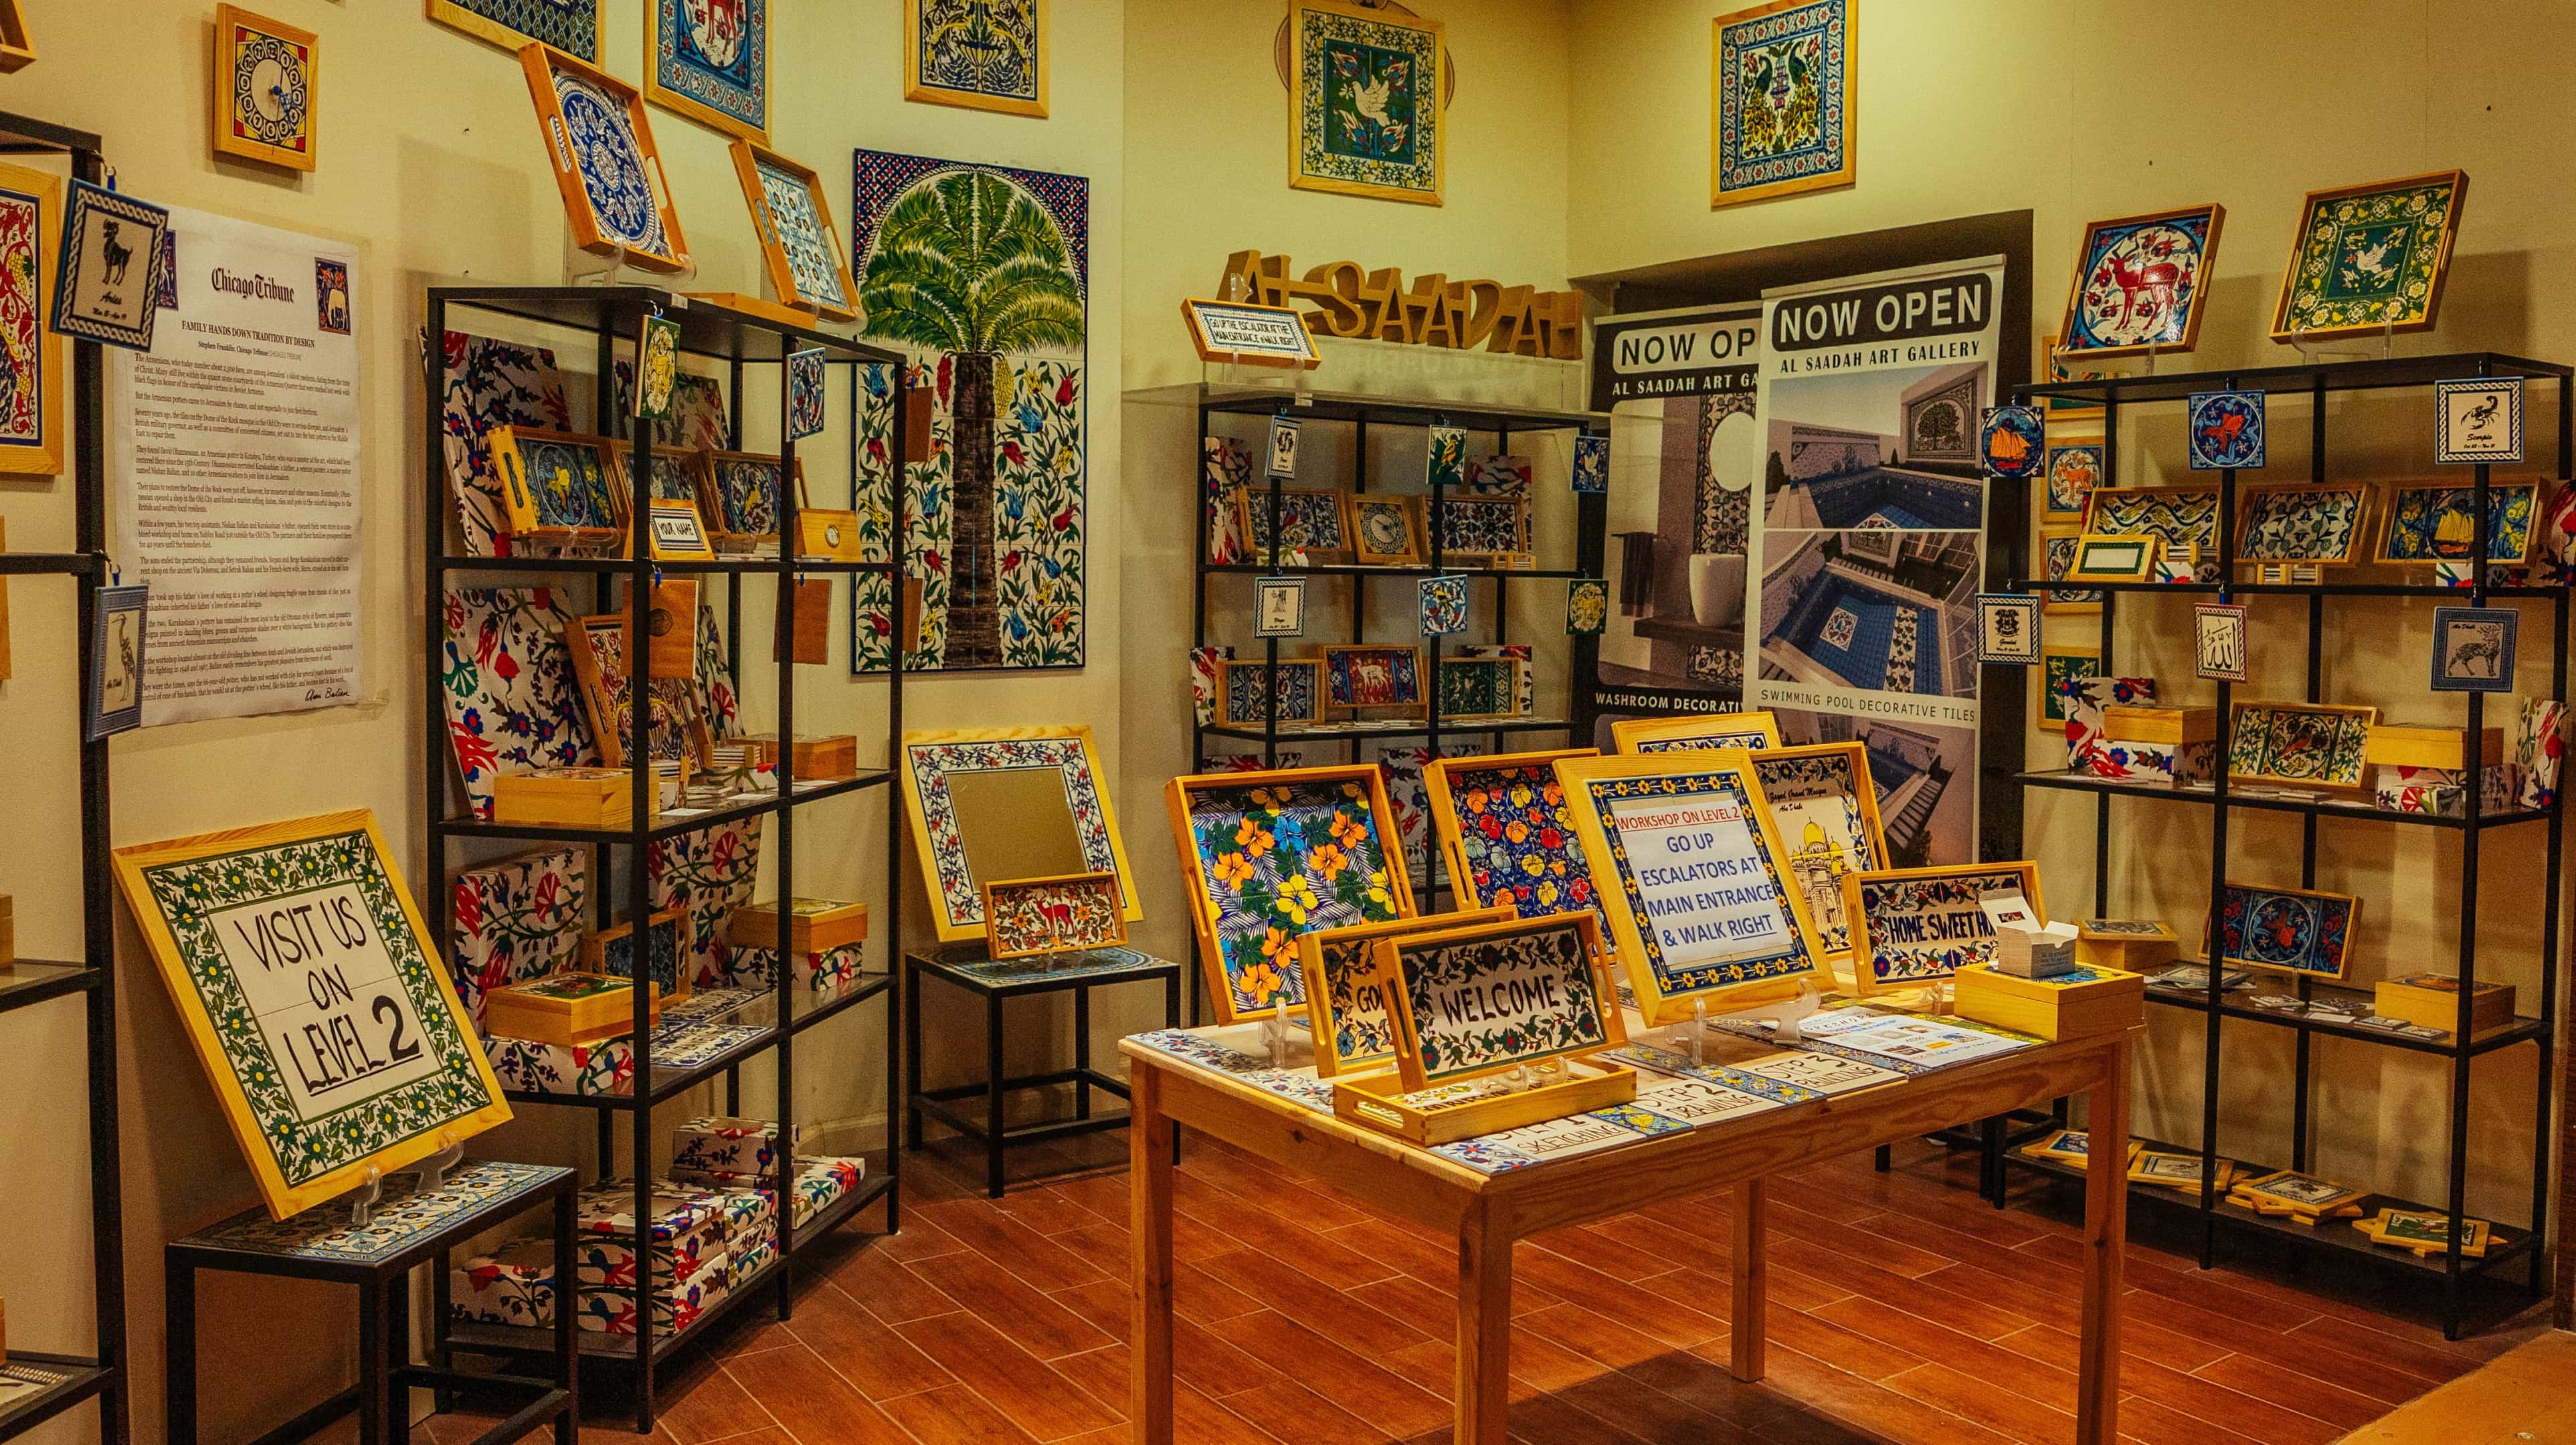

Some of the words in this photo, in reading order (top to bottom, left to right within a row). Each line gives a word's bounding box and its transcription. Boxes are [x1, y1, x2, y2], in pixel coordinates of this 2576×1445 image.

[211, 268, 254, 298] Chicago
[254, 274, 294, 304] Tribune
[1779, 299, 1861, 343] NOW
[1875, 284, 1983, 333] OPEN
[182, 320, 207, 332] FAMILY
[209, 324, 231, 336] HANDS
[232, 328, 252, 340] DOWN
[253, 331, 285, 344] TRADITION
[286, 334, 293, 345] BY
[294, 336, 315, 348] DESIGN
[135, 353, 145, 362] The
[1621, 333, 1695, 367] NOW
[1780, 359, 1798, 374] AL
[1807, 352, 1862, 371] SAADAH
[1869, 348, 1899, 365] ART
[1908, 340, 1980, 362] GALLERY
[1613, 381, 1630, 397] AL
[1637, 377, 1695, 394] SAADAH
[1703, 375, 1733, 389] ART
[658, 522, 676, 536] YOUR
[674, 522, 693, 536] NAME
[1595, 692, 1669, 710] WASHROOM
[1673, 698, 1744, 714] DECORATI
[1761, 689, 1821, 706] SWIMMING
[1827, 695, 1855, 710] POOL
[1859, 698, 1937, 718] DECORATIVE
[1942, 706, 1975, 722] TILES
[1616, 813, 1679, 830] WORKSHOP
[1683, 811, 1699, 824] ON
[1700, 807, 1731, 822] LEVEL
[1732, 807, 1740, 818] 2
[1667, 835, 1691, 853] GO
[1693, 833, 1714, 849] UP
[1641, 859, 1738, 887] ESCALATORS
[1740, 856, 1758, 874] AT
[1648, 894, 1695, 918] MAIN
[1695, 884, 1775, 910] ENTRANCE
[234, 904, 323, 972] VISIT
[320, 896, 367, 950] US
[1663, 929, 1678, 947] &
[1678, 920, 1730, 944] WALK
[1728, 914, 1773, 938] RIGHT
[1888, 914, 1928, 945] HOME
[1927, 911, 1975, 941] SWEET
[308, 963, 353, 1011] ON
[1440, 975, 1560, 1027] WELCOME
[283, 1014, 387, 1094] LEVEL
[372, 995, 421, 1062] 2
[1755, 1058, 1813, 1080] STEP
[1805, 1055, 1848, 1068] 3
[1795, 1066, 1876, 1089] PAINTING
[1635, 1086, 1697, 1108] STEP
[1684, 1083, 1728, 1095] 2
[1665, 1094, 1754, 1119] DRAWING
[1517, 1123, 1622, 1153] SKETCHING
